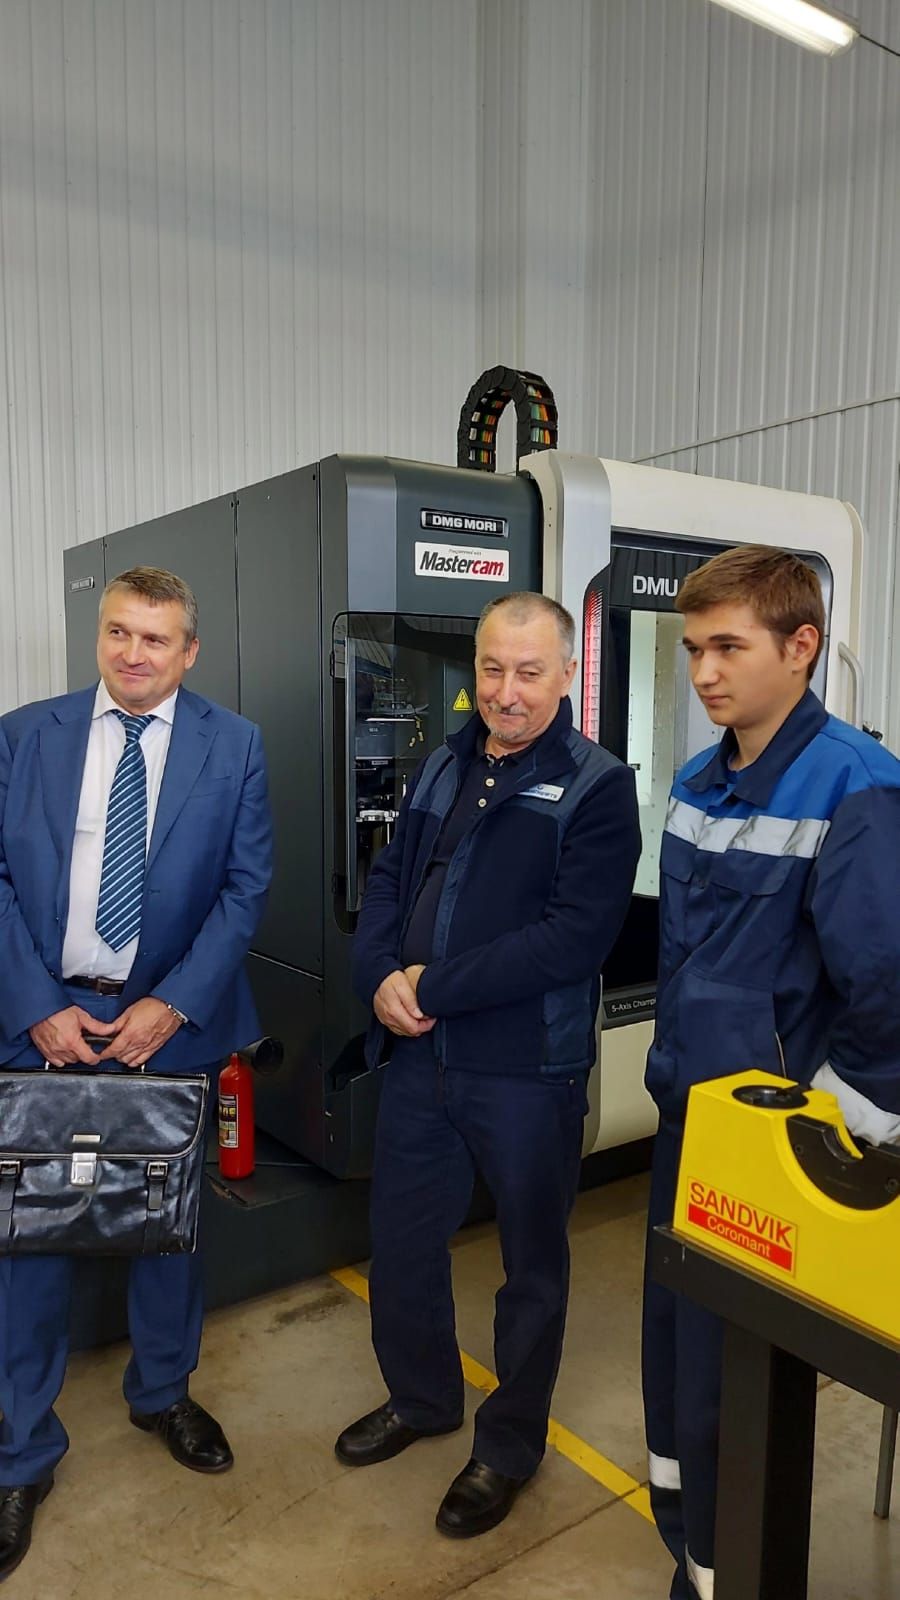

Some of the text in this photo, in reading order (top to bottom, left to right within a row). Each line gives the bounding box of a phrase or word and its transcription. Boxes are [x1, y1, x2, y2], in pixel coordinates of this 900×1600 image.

[432, 515, 497, 532] DMG MORI
[419, 550, 505, 576] Mastercam
[632, 575, 679, 597] DMU
[690, 1181, 793, 1249] SANDVIK
[707, 1215, 771, 1258] Coromant
